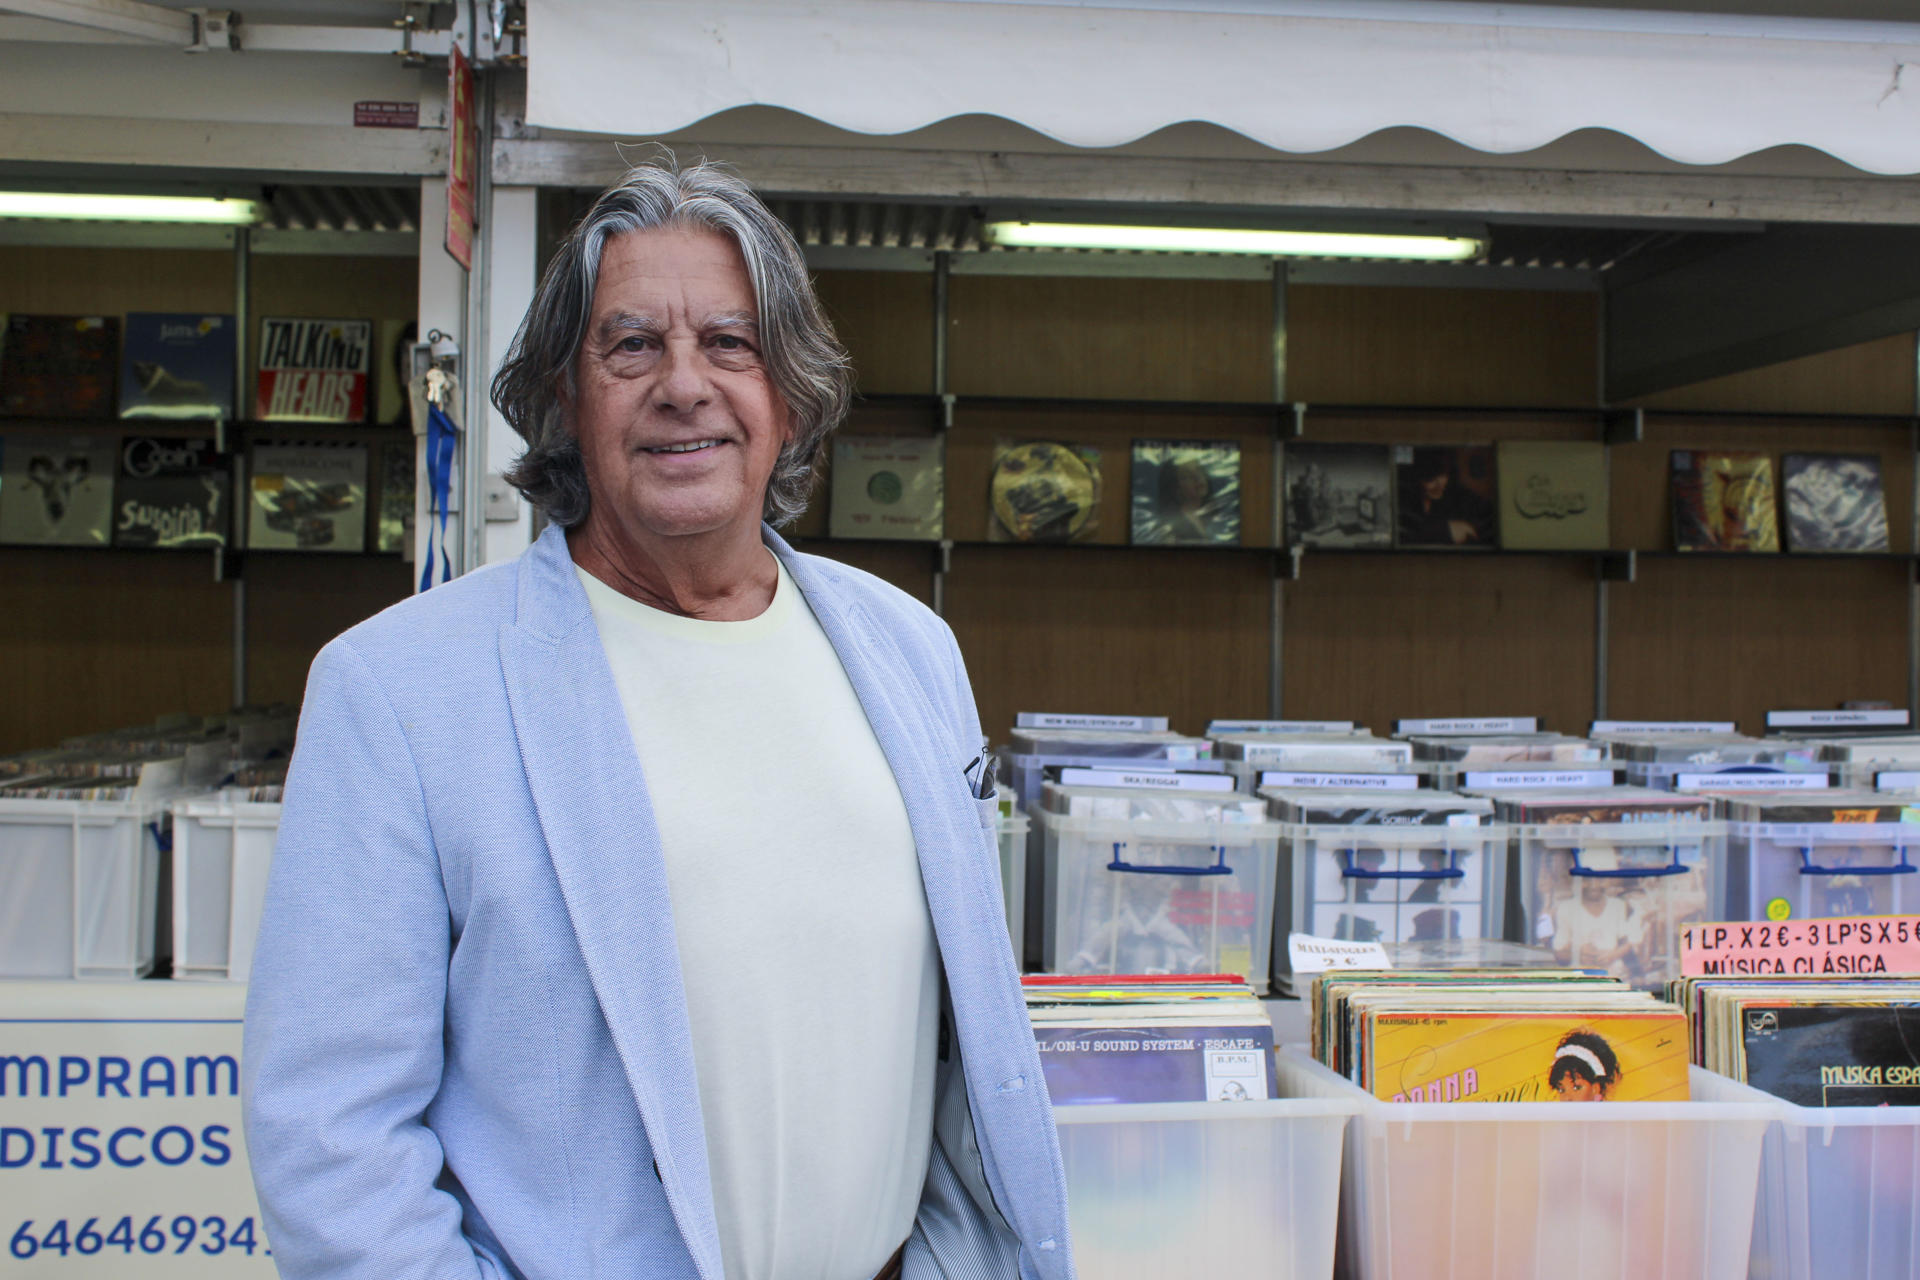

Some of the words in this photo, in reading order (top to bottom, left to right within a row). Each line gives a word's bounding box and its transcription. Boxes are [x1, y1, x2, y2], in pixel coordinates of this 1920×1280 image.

[263, 321, 366, 370] TALKING
[269, 372, 354, 421] HEADS
[1293, 777, 1318, 785] INDIE
[1328, 777, 1387, 786] ALTERNATIVE
[1683, 929, 1693, 950] 1
[1702, 928, 1734, 949] LP.
[1741, 927, 1753, 949] X
[1760, 926, 1771, 948] 2
[1777, 926, 1789, 947] €
[1808, 924, 1819, 946] 3
[1878, 921, 1892, 943] X
[1897, 921, 1909, 943] 5
[1703, 954, 1786, 974] MÚSICA
[1093, 1040, 1140, 1052] SOUND
[1142, 1039, 1195, 1051] SYSTEM
[1204, 1038, 1254, 1050] ESCAPE
[1821, 1065, 1882, 1085] MUSICA
[0, 1125, 232, 1170] DISCOS
[9, 1215, 272, 1260] 64646934
